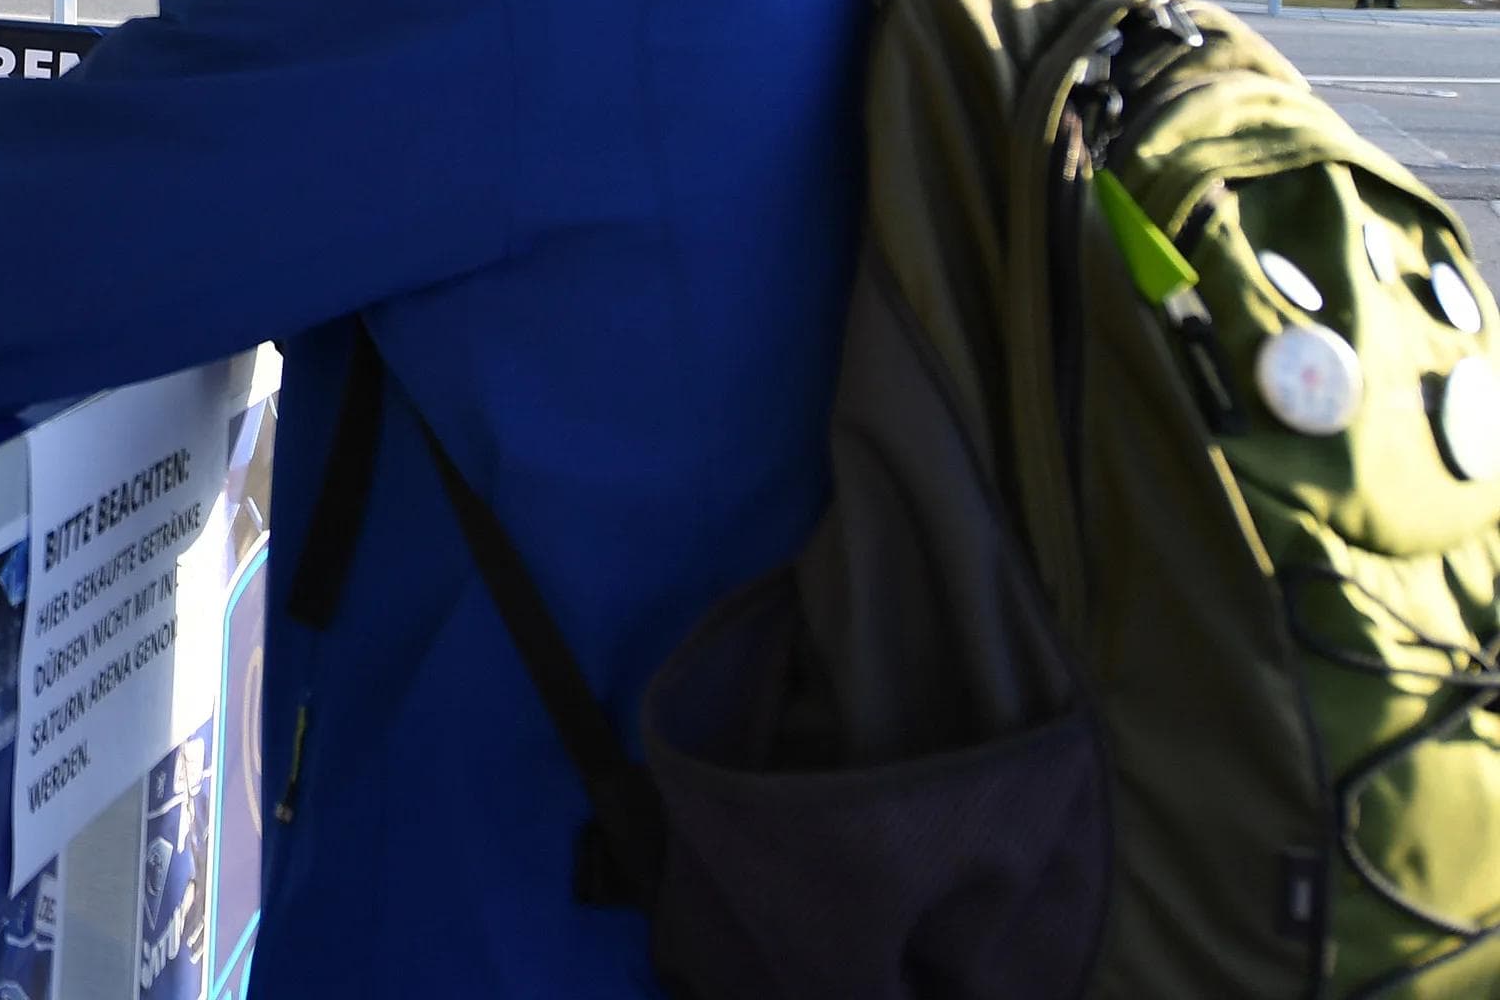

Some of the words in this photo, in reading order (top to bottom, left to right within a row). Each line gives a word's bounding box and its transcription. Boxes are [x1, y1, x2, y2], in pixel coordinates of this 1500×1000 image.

[36, 591, 70, 636] HIER
[73, 542, 137, 611] GEKAUFTE
[139, 502, 202, 565] GETRÄNKE
[44, 504, 94, 573] BITTE
[97, 448, 191, 535] BEACHTEN:
[33, 629, 90, 697] DÜRFEN
[92, 598, 133, 648] NICHT
[135, 580, 157, 621] MIT
[29, 686, 87, 757] SATURN
[90, 651, 132, 706] ARENA
[27, 739, 92, 814] WERDEN.
